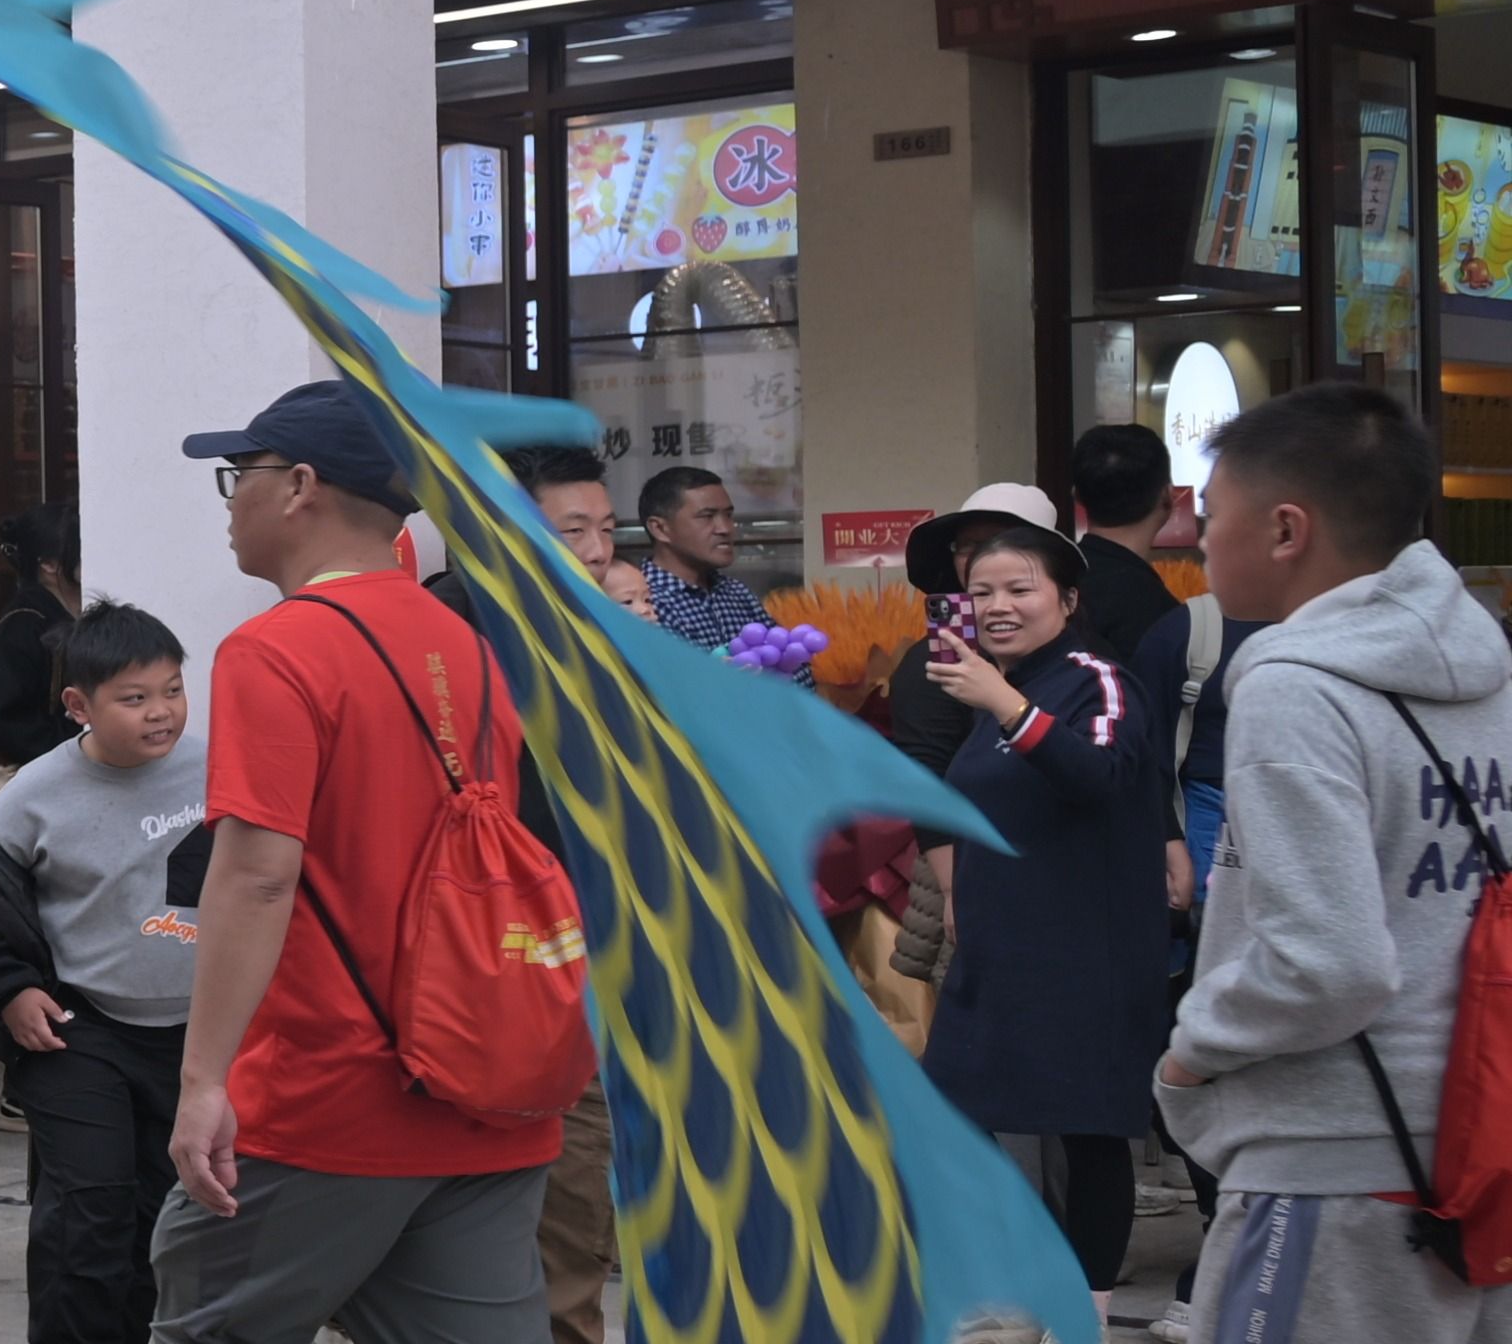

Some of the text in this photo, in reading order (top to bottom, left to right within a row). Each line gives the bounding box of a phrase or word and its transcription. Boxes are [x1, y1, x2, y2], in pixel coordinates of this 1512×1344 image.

[728, 137, 788, 193] 冰
[1266, 1216, 1290, 1260] DREAM
[1257, 1257, 1280, 1295] MAKE
